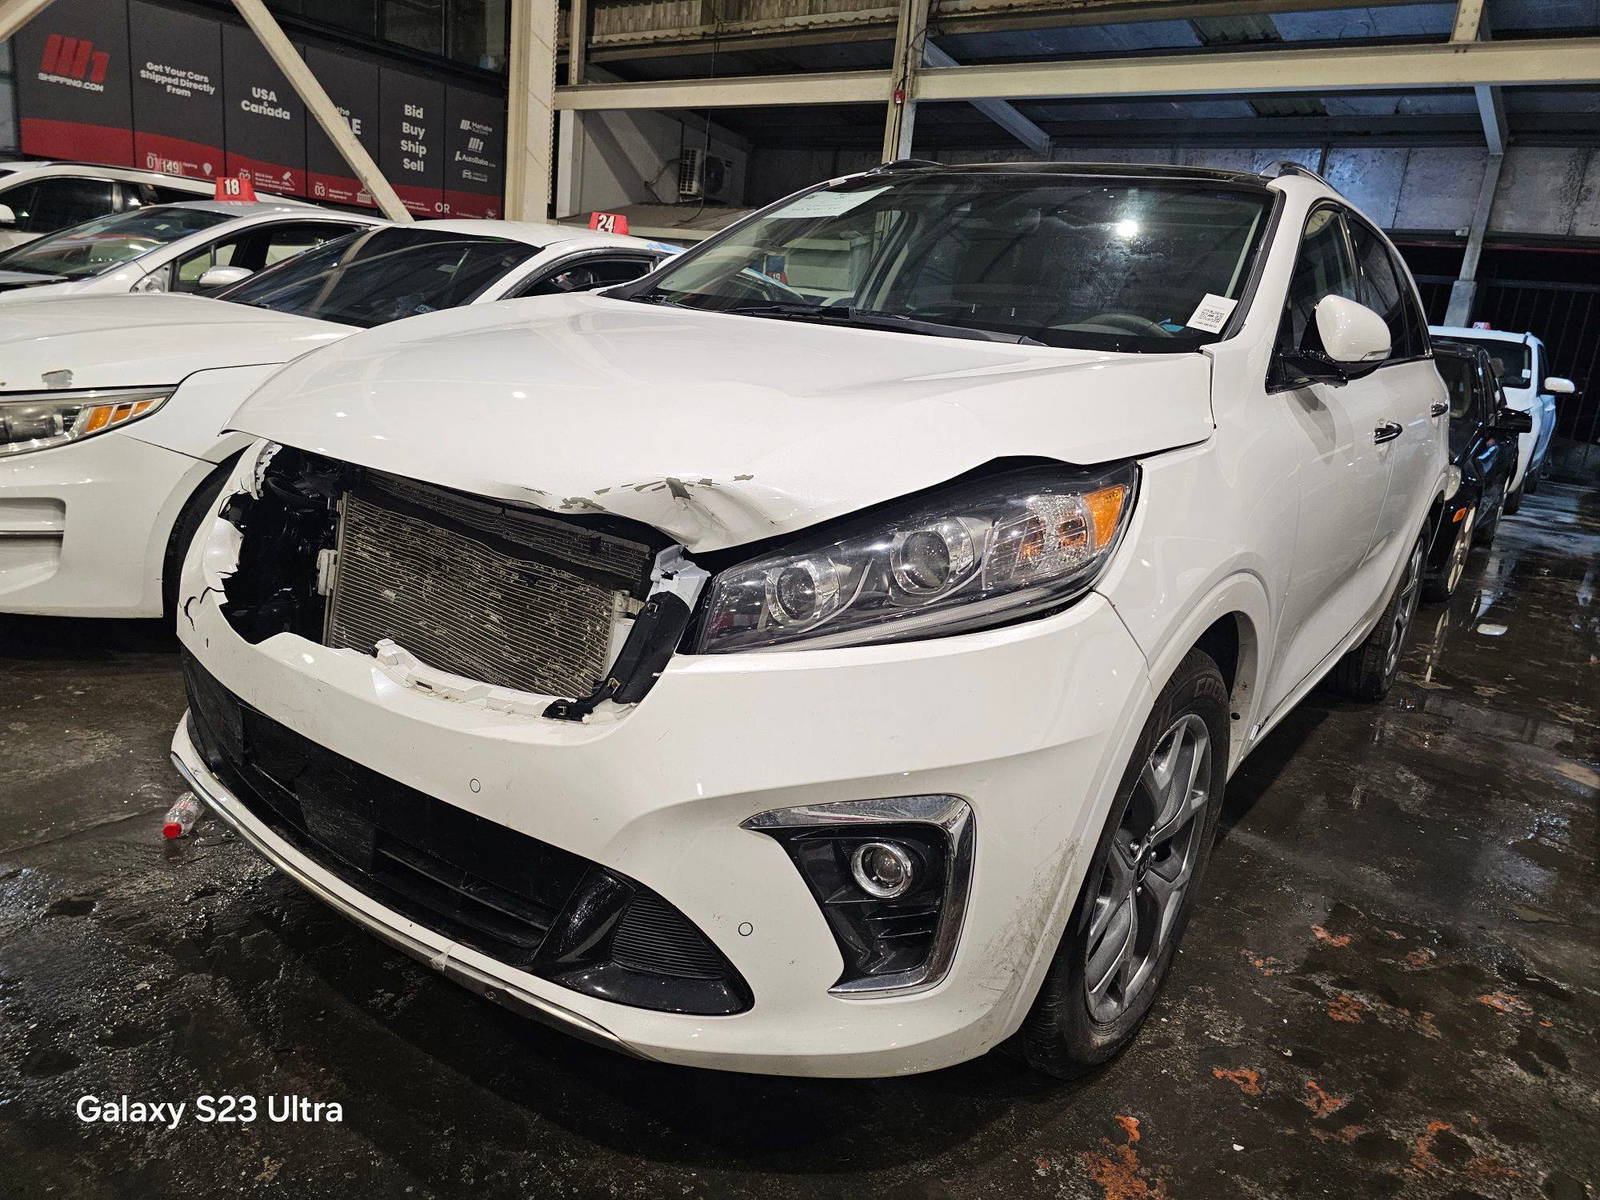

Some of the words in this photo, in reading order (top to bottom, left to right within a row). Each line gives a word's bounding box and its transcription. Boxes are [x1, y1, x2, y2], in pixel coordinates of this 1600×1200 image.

[146, 61, 163, 73] Get
[164, 65, 187, 77] Your
[187, 70, 209, 83] Cars
[140, 69, 179, 85] Shipped
[180, 77, 215, 95] Directly
[166, 84, 191, 97] From
[251, 86, 277, 102] USA
[241, 99, 290, 120] Canada
[404, 104, 424, 119] Bid
[402, 122, 426, 140] Buy
[400, 139, 427, 158] Ship
[403, 157, 424, 173] Sell
[224, 179, 240, 196] 18
[314, 185, 326, 197] 03
[434, 202, 450, 214] OR
[597, 214, 615, 234] 24
